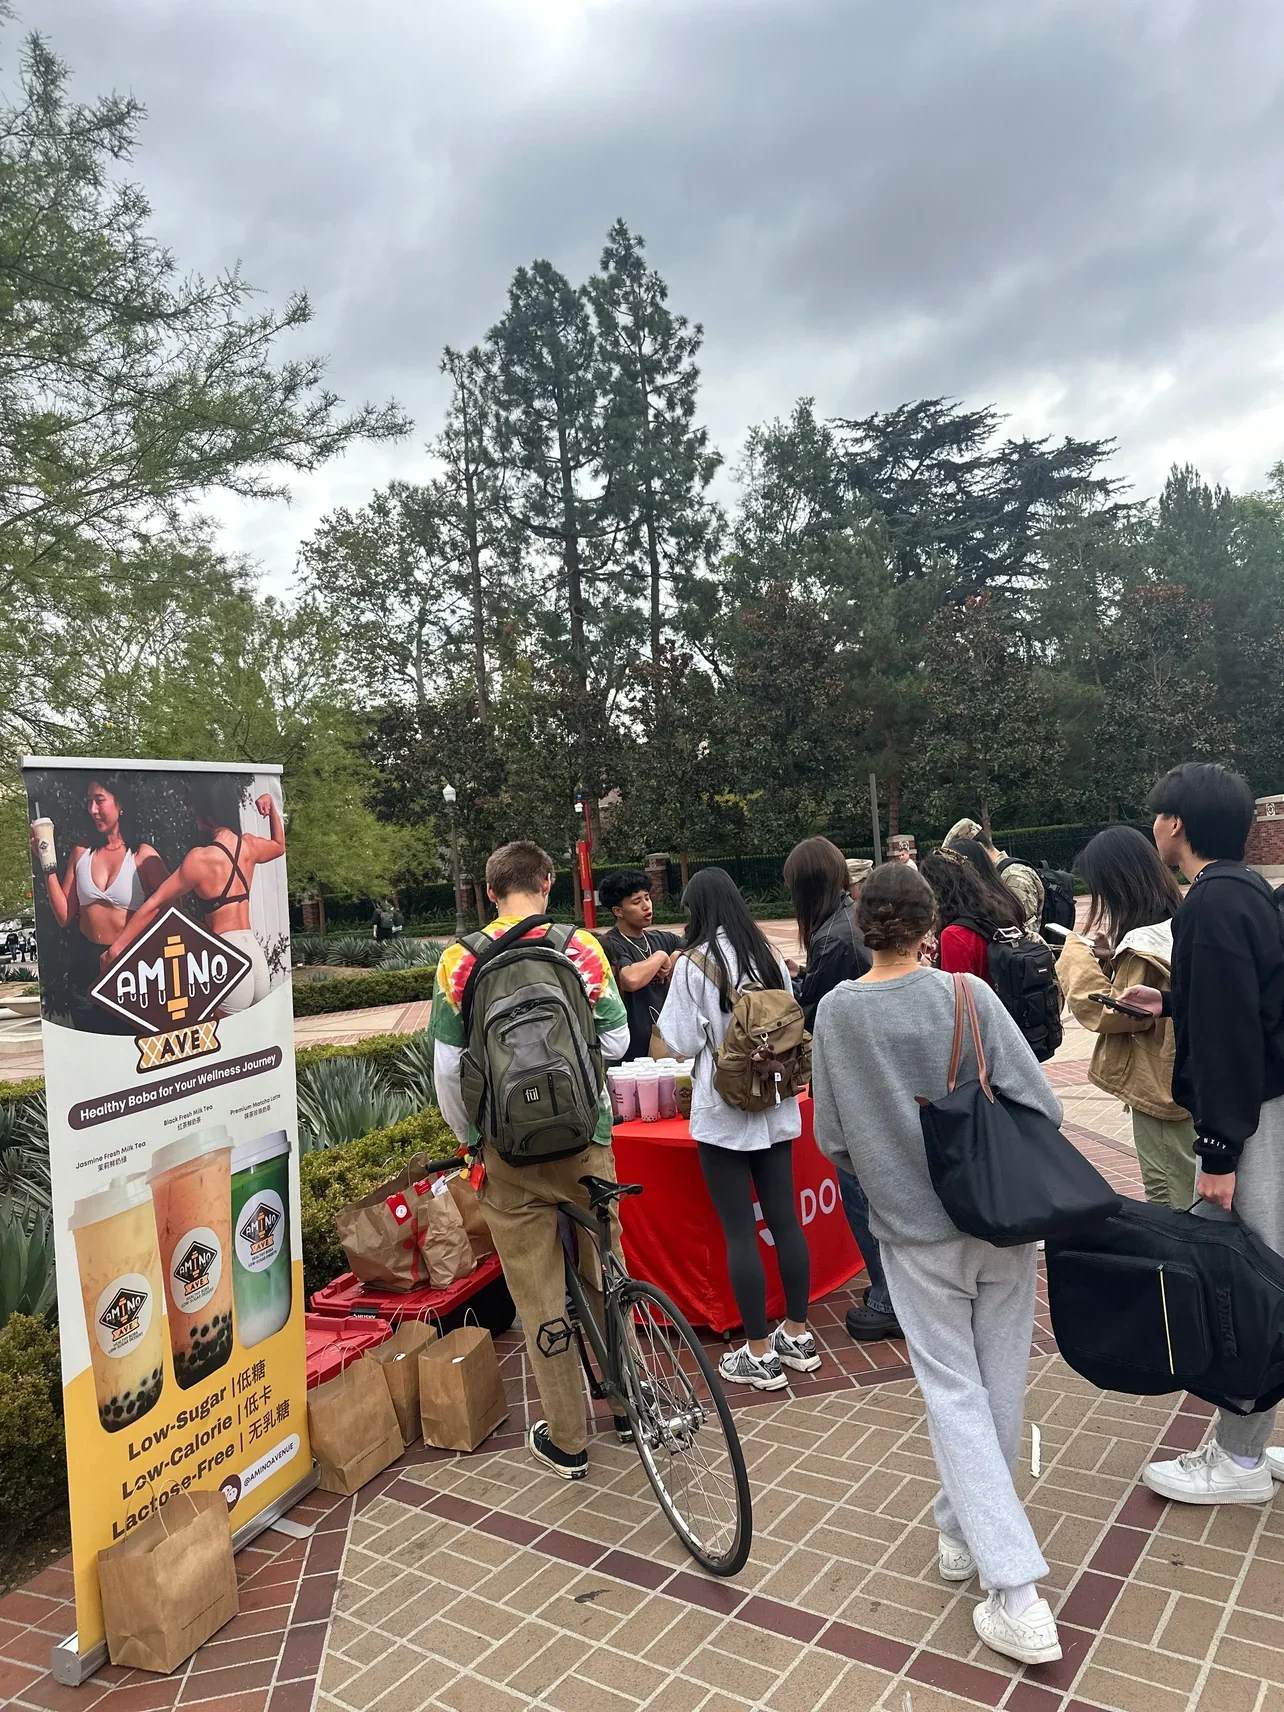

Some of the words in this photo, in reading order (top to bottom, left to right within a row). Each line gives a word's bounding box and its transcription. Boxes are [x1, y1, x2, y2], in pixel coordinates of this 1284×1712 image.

[117, 935, 228, 1020] AMINO
[160, 1029, 200, 1060] AVE
[80, 1099, 127, 1121] Healthy
[128, 1090, 157, 1107] Boba
[158, 1085, 174, 1098] for
[174, 1078, 197, 1093] Your
[197, 1065, 241, 1085] Wellness
[242, 1054, 277, 1072] Journey
[163, 1116, 179, 1127] Black
[178, 1111, 192, 1121] Fresh
[192, 1107, 203, 1116] Milk
[203, 1104, 214, 1112] Tea
[229, 1104, 252, 1116] Premium
[252, 1098, 270, 1108] Matcha
[75, 1155, 103, 1169] Jasmine
[103, 1149, 121, 1160] Fresh
[121, 1144, 134, 1154] Milk
[134, 1141, 146, 1150] Tea
[800, 1178, 842, 1226] DO
[245, 1212, 276, 1238] AMINO
[256, 1239, 269, 1250] AVE
[180, 1251, 211, 1278] AMINO
[190, 1279, 204, 1291] AVE
[105, 1297, 141, 1324] AMINO
[119, 1323, 134, 1336] AVE
[128, 1386, 227, 1461] Low-Sugar
[236, 1359, 266, 1394] 低糖
[248, 1398, 290, 1445] 无乳糖
[122, 1415, 233, 1500] Low-Calorie
[243, 1384, 272, 1419] 低卡
[243, 1442, 294, 1487] @AMINOAVENUE
